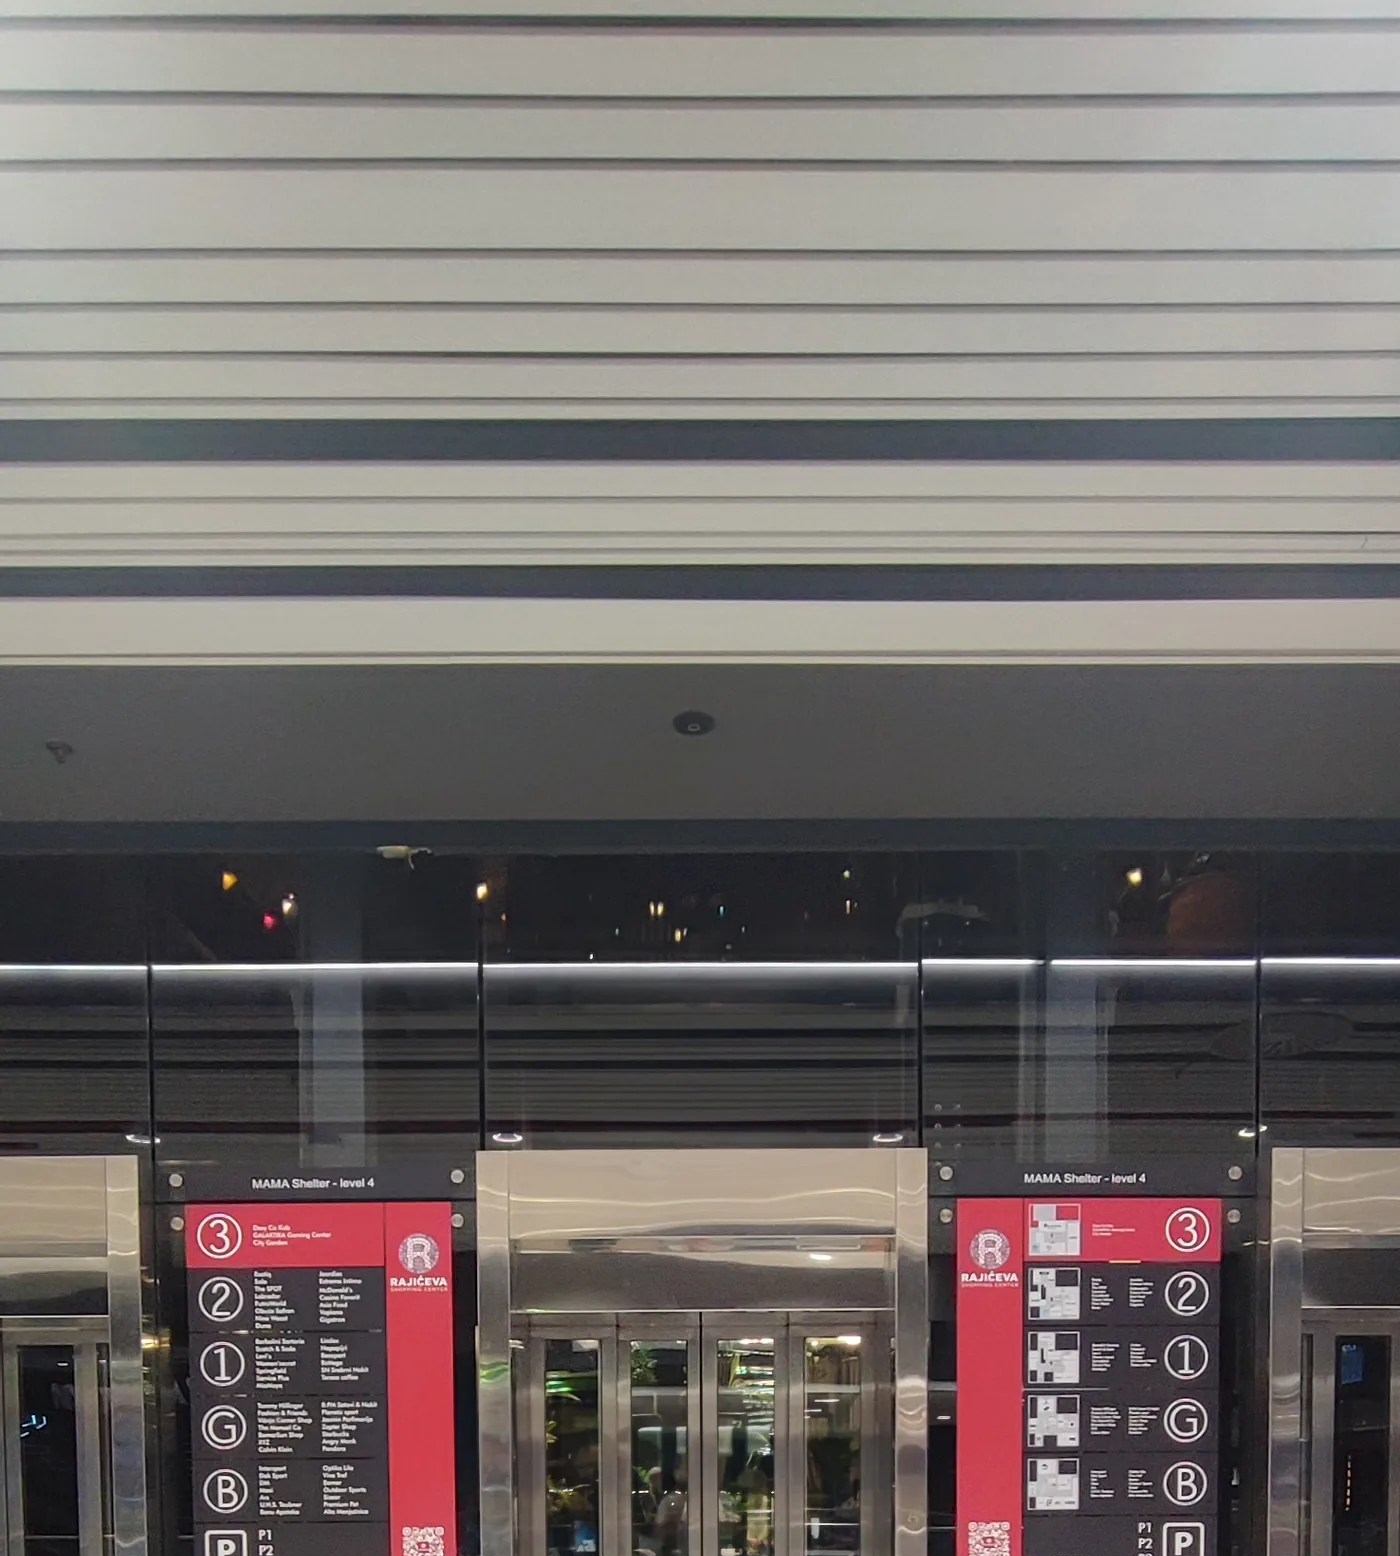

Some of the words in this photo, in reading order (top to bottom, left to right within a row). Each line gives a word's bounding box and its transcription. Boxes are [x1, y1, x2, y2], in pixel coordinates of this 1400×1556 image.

[252, 1179, 290, 1189] MAMA
[292, 1178, 330, 1188] Shelter
[340, 1178, 365, 1187] level
[367, 1178, 375, 1187] 4
[1024, 1173, 1061, 1183] MAMA
[1064, 1173, 1102, 1183] Shelter
[1111, 1173, 1137, 1183] level
[1138, 1173, 1146, 1183] 4
[209, 1219, 230, 1254] 3
[1177, 1213, 1198, 1247] 3
[212, 1282, 231, 1316] 2
[1177, 1277, 1196, 1310] 2
[214, 1348, 231, 1381] 1
[1177, 1340, 1195, 1374] 1
[208, 1412, 237, 1444] G
[1170, 1404, 1198, 1437] G
[217, 1476, 238, 1507] B
[1177, 1468, 1197, 1501] B
[259, 1530, 272, 1541] P1
[1138, 1522, 1152, 1533] P1
[1138, 1538, 1153, 1549] P2
[1175, 1531, 1193, 1556] P
[259, 1545, 274, 1556] P2
